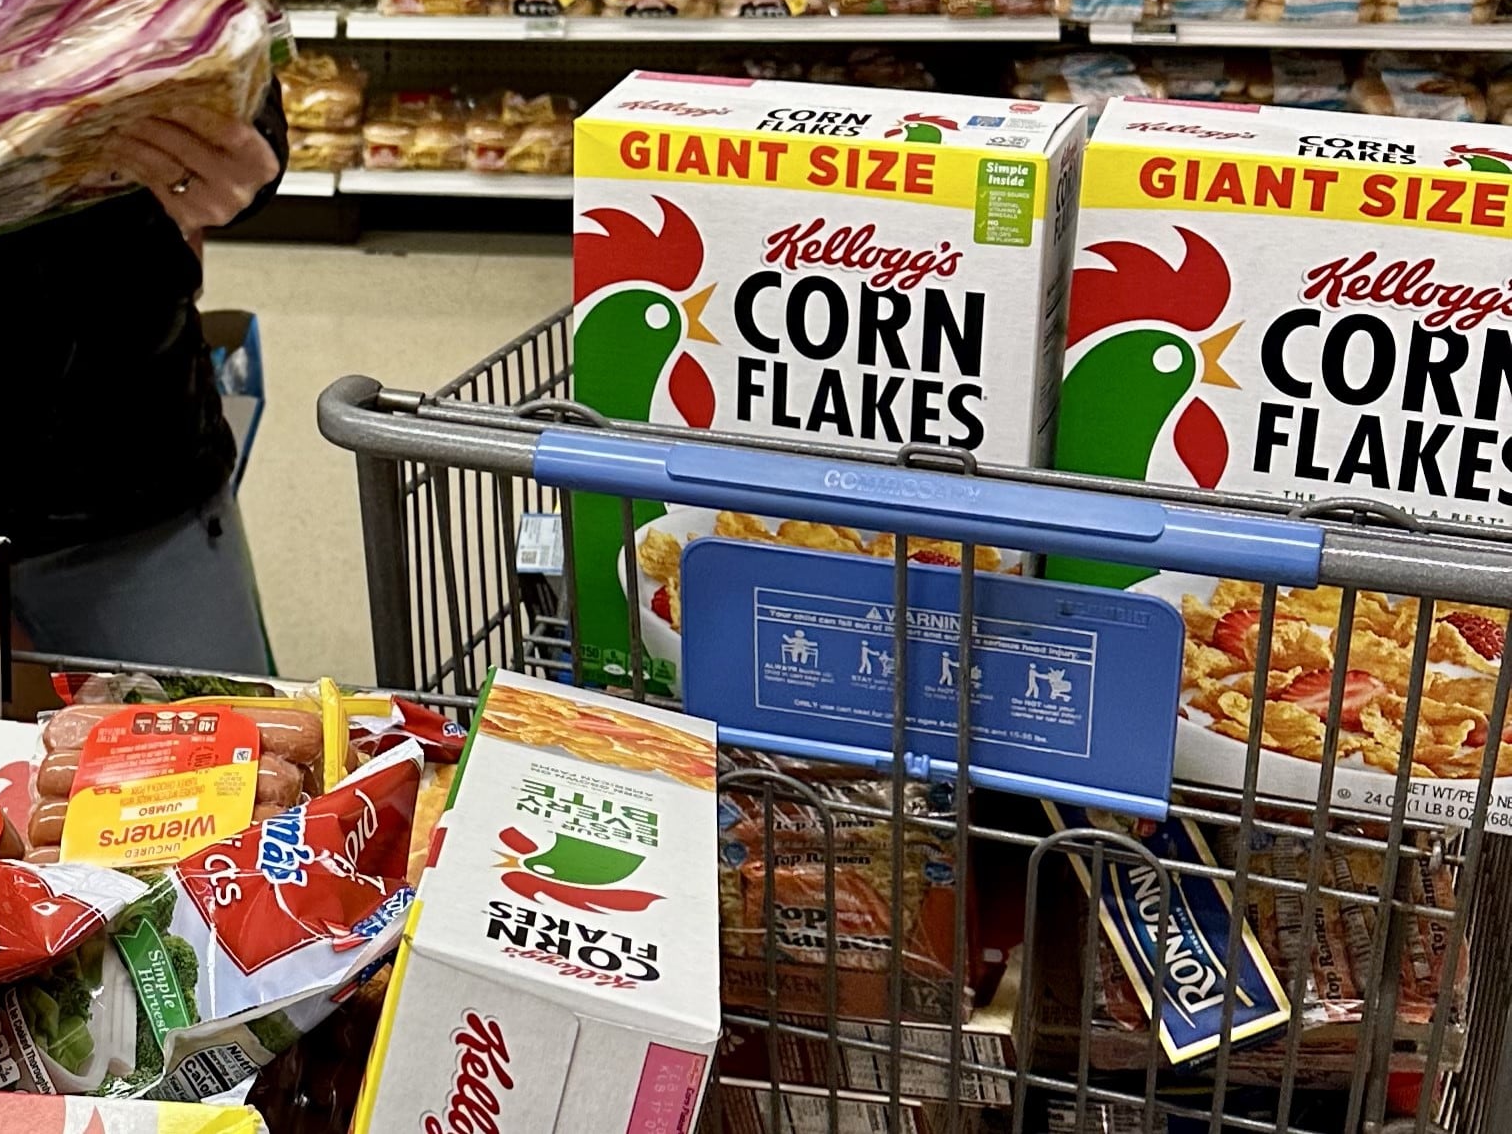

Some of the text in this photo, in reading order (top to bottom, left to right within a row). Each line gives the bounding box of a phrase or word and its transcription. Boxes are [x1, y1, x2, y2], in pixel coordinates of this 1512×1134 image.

[617, 98, 734, 117] Kellogg's
[765, 108, 873, 126] CORN
[756, 120, 863, 138] FLAKES
[1126, 121, 1259, 139] Kellogg's
[1298, 136, 1416, 155] CORN
[619, 130, 936, 195] GIANT SIZE
[986, 162, 1029, 175] Simple
[1298, 145, 1418, 165] FLAKES
[989, 175, 1024, 186] Inside
[1139, 157, 1339, 212] GIANT
[1360, 173, 1510, 228] SIZE
[766, 217, 963, 290] Kellogg's
[1304, 251, 1512, 330] Kellogg'
[733, 270, 986, 377] CORN
[737, 357, 986, 451] FLAKES
[1253, 401, 1512, 506] FLAKE
[1283, 490, 1316, 501] THE
[1451, 512, 1494, 525] BEST
[769, 610, 791, 619] Your
[792, 612, 816, 622] child
[818, 616, 836, 625] can
[983, 638, 1019, 651] serious
[1049, 647, 1080, 660] injury.
[139, 802, 182, 816] JUMBO
[517, 795, 658, 837] EVERY
[520, 779, 658, 826] BITE
[1364, 791, 1382, 803] 24
[1425, 801, 1442, 815] LB
[1445, 804, 1454, 816] 8
[99, 815, 215, 847] Wieners
[516, 802, 658, 847] BEST IN
[561, 822, 610, 840] OUR
[125, 843, 181, 859] UNCURED
[806, 853, 871, 865] Rmen
[486, 918, 660, 982] CORN
[489, 901, 658, 962] FLAKES
[1430, 921, 1448, 956] Top
[501, 946, 638, 989] Kellogg's
[1315, 907, 1342, 1000] Top Ramen
[148, 949, 176, 1009] Simple
[724, 968, 823, 992] CHIKEN
[138, 968, 170, 1034] Harvest
